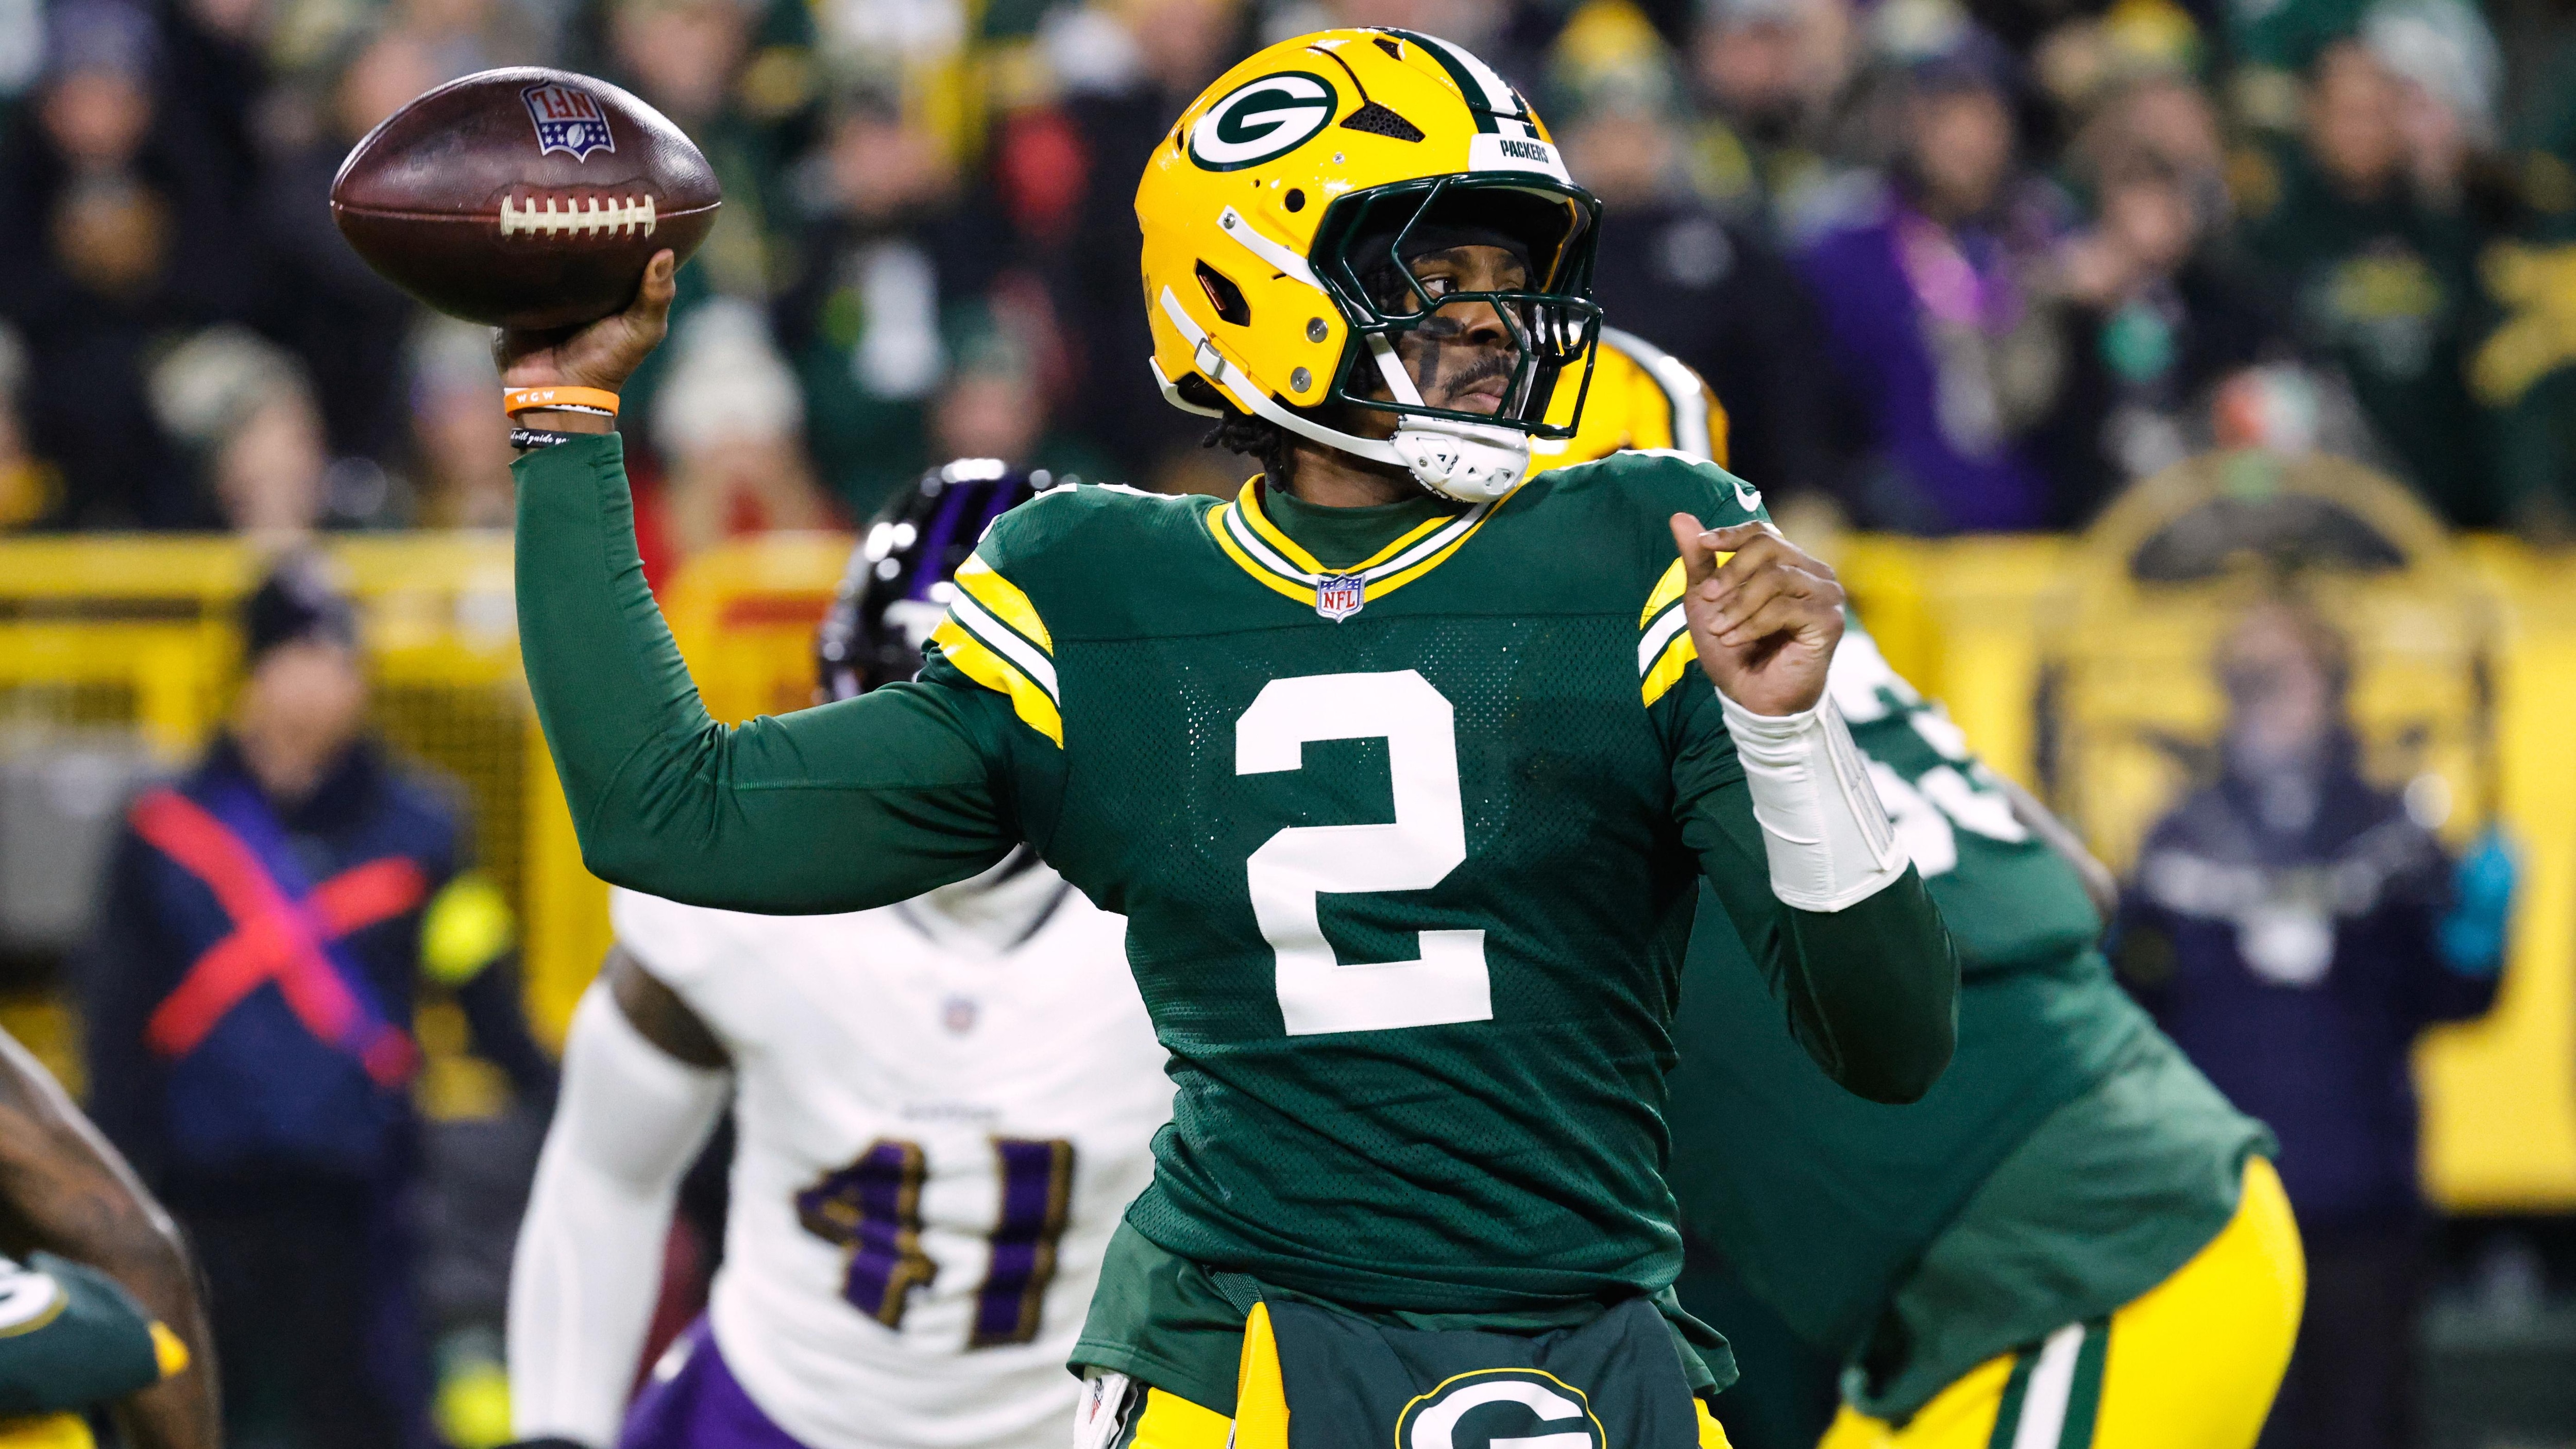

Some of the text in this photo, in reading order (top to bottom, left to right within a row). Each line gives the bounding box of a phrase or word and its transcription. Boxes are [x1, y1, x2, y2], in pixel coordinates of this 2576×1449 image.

[531, 87, 596, 119] NFL
[1193, 76, 1328, 163] G
[1500, 140, 1549, 164] PACKERS
[527, 433, 554, 445] guide
[1324, 591, 1355, 611] NFL
[1235, 669, 1493, 1036] 2
[792, 1135, 1074, 1347] 41
